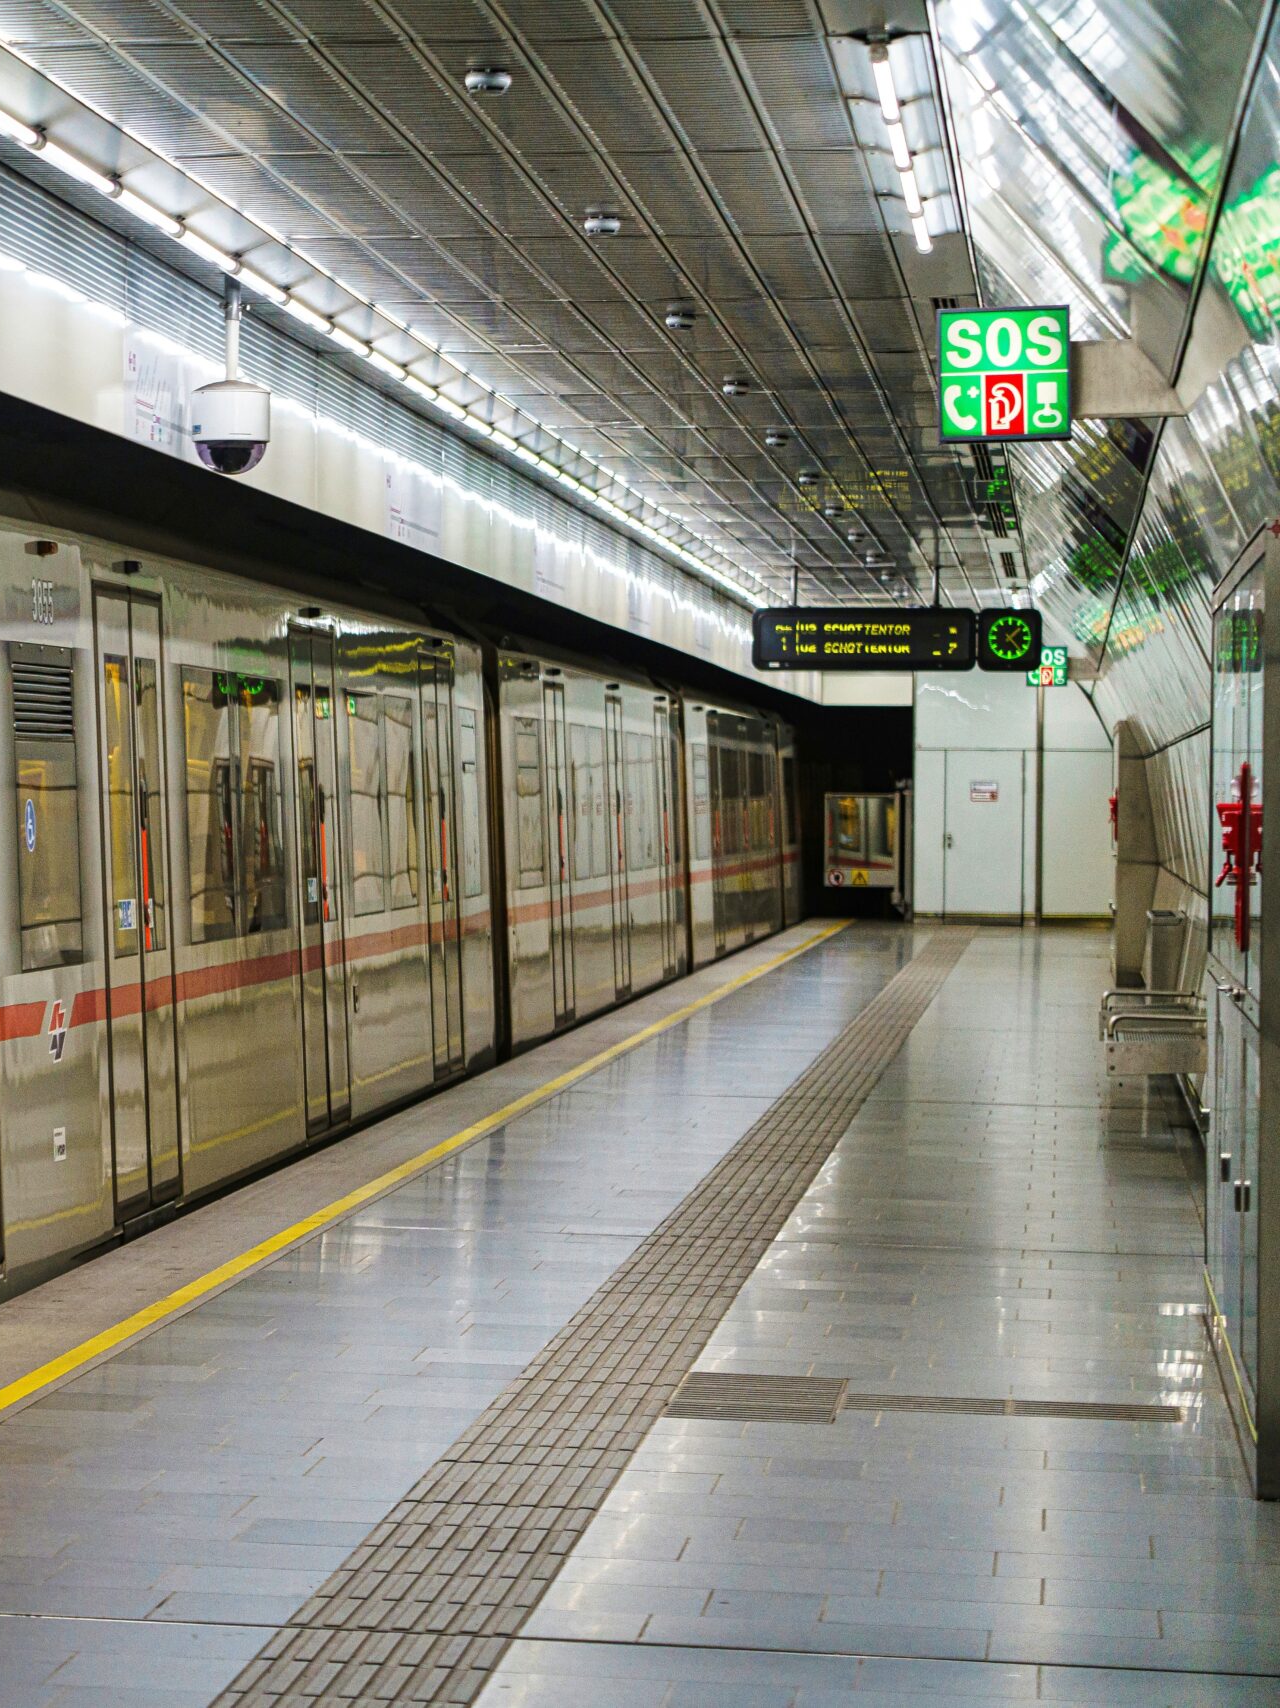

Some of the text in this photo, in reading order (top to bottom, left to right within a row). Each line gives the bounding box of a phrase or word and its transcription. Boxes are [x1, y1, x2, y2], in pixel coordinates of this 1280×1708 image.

[945, 316, 1063, 369] SOS
[31, 578, 54, 625] 3855
[1041, 649, 1066, 666] OS
